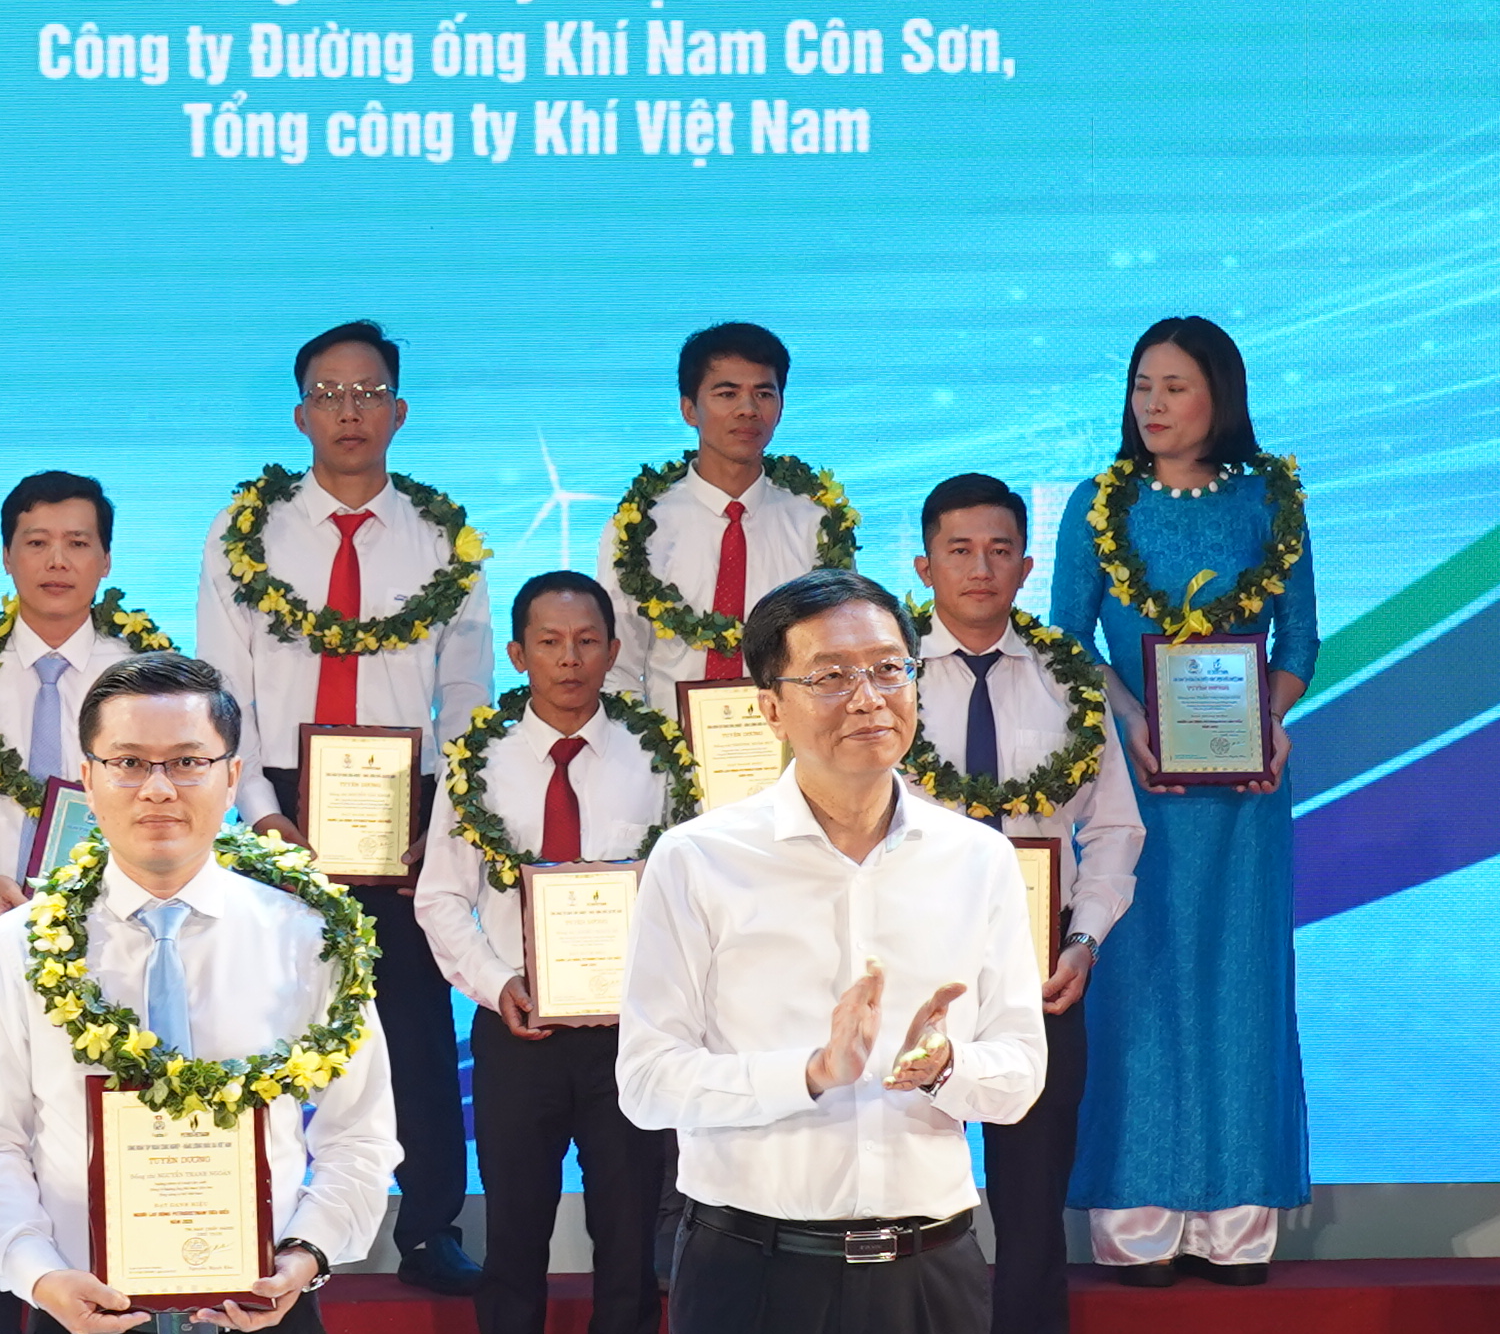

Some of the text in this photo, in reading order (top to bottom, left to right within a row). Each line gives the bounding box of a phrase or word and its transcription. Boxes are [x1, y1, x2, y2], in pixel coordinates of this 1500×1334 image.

[38, 12, 1014, 86] Công ty Đường ống Khí Nam Côn Sơn,
[183, 89, 869, 167] Tổng công ty Khí Việt Nam
